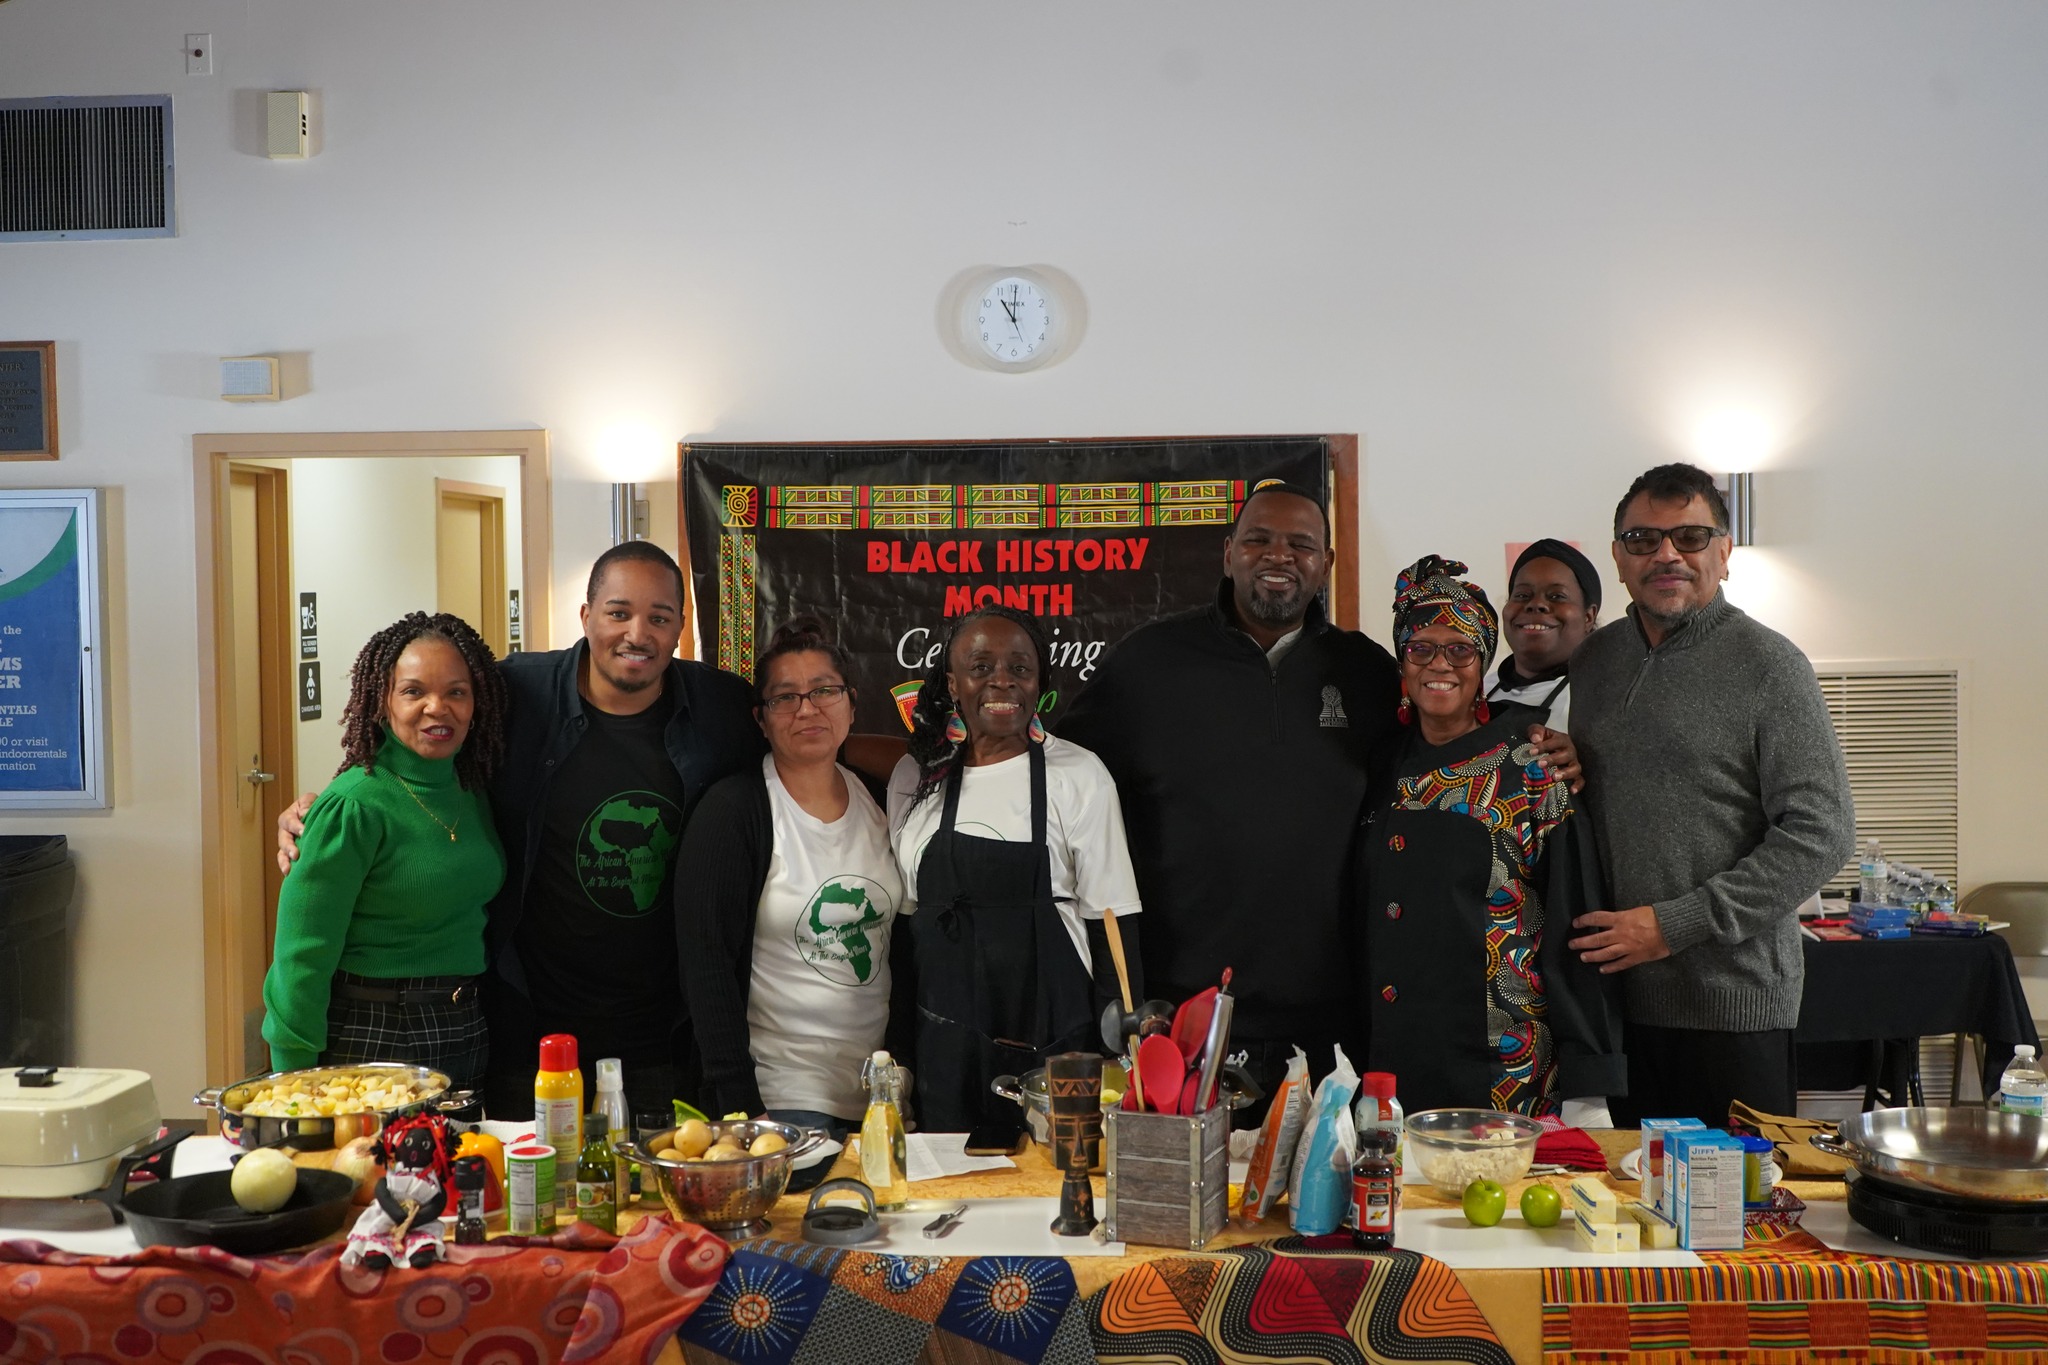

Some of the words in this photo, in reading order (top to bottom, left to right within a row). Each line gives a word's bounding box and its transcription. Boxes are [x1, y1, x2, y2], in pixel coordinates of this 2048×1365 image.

[983, 299, 991, 308] 10
[1039, 299, 1044, 308] 2
[979, 316, 985, 324] 9
[1044, 316, 1049, 325] 3
[983, 332, 988, 341] 8
[1038, 333, 1044, 341] 4
[996, 344, 1002, 352] 7
[1011, 348, 1017, 356] 6
[1027, 344, 1033, 352] 5
[867, 541, 983, 573] BLACK
[996, 538, 1149, 573] HISTORY
[943, 584, 1073, 617] MONTH
[3, 625, 22, 635] the
[26, 737, 48, 746] visit
[579, 854, 592, 868] The
[593, 854, 622, 871] African
[586, 876, 596, 888] At
[597, 876, 609, 888] The
[797, 936, 808, 944] The
[813, 936, 836, 949] African
[808, 951, 817, 961] At
[818, 951, 829, 961] The
[1691, 1147, 1715, 1155] JIFFY
